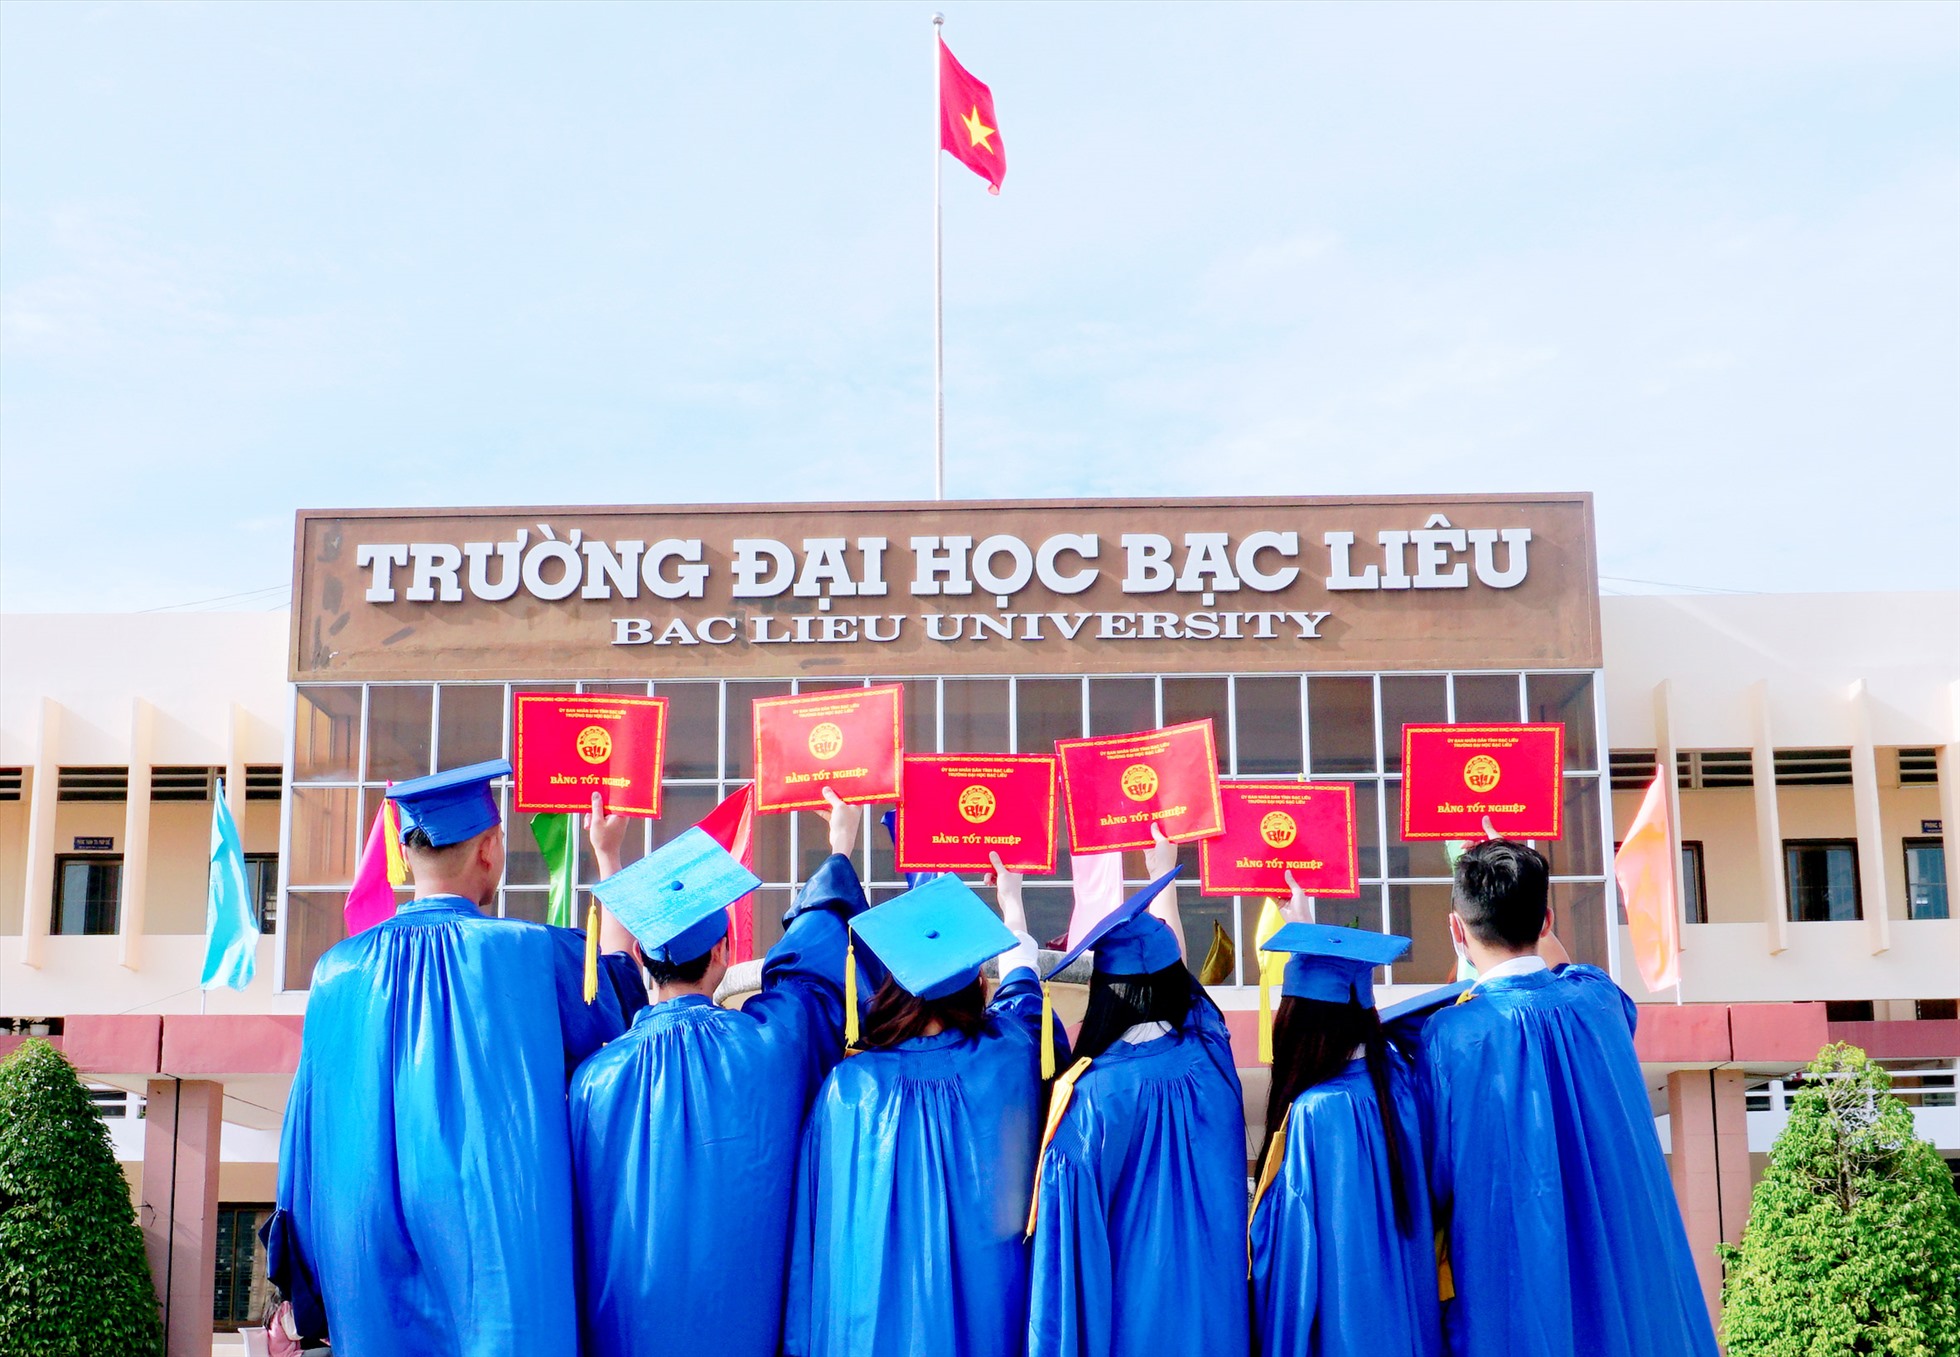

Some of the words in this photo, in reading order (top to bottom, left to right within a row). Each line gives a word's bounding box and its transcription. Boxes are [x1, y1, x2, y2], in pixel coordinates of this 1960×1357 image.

[357, 524, 709, 603] TRƯỜNG
[731, 537, 888, 611] ĐẠI
[910, 533, 1100, 608] HỌC
[1121, 531, 1300, 606] BẠC
[1325, 514, 1531, 590] LIÊU
[610, 616, 738, 645] BAC
[751, 614, 907, 643] LIEU
[924, 611, 1331, 641] UNIVERSITY
[550, 773, 577, 784] BẰNG
[581, 774, 600, 785] TỐT
[602, 776, 631, 788] NGHIỆP
[785, 772, 810, 784] BẰNG
[813, 769, 831, 781] TỐT
[833, 767, 868, 778] NGHIỆP
[1100, 811, 1127, 826] BẰNG
[1130, 811, 1149, 823] TỐT
[1152, 806, 1187, 820] NGHIỆP
[1438, 802, 1464, 813] BẰNG
[1467, 802, 1486, 813] TỐT
[1488, 803, 1526, 814] NGHIỆP
[932, 832, 959, 844] BẰNG
[962, 833, 981, 844] TỐT
[984, 834, 1021, 846] NGHIỆP
[1236, 857, 1263, 868] BẰNG
[1266, 858, 1283, 869] TỐT
[1286, 859, 1323, 870] NGHIỆP
